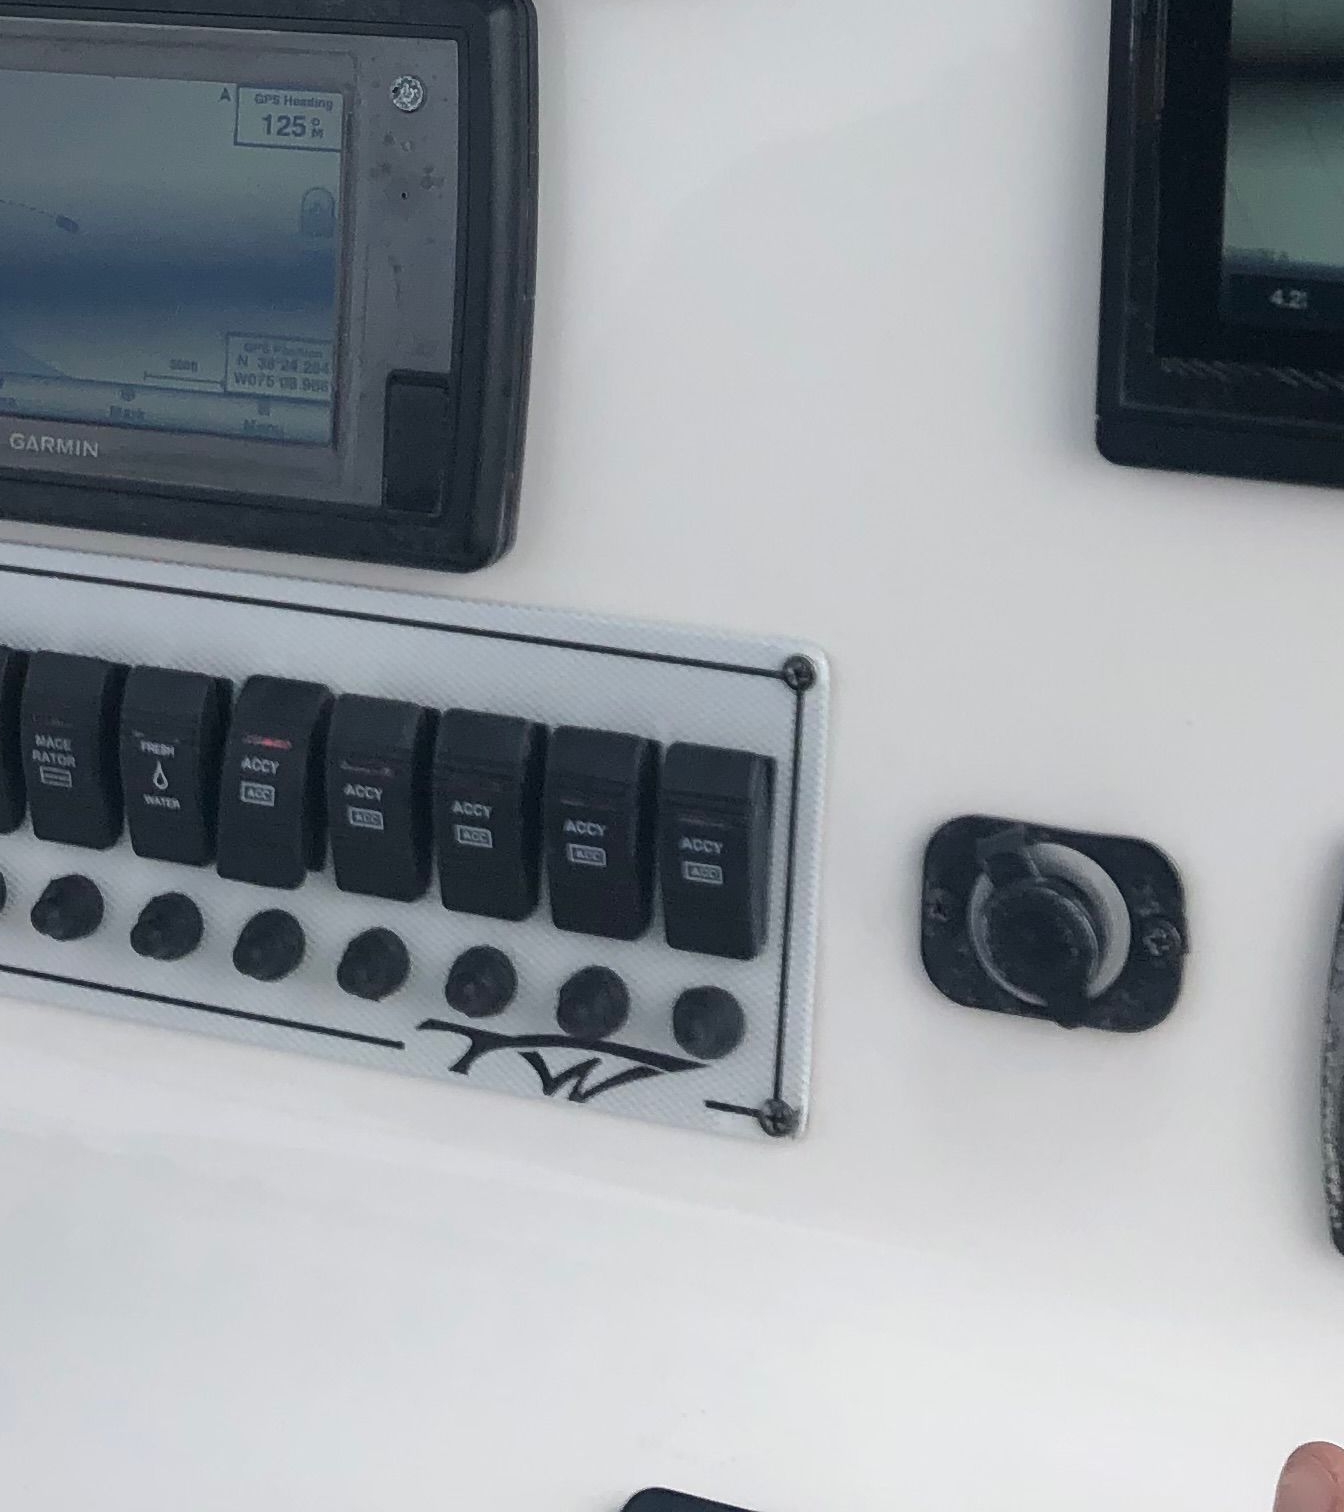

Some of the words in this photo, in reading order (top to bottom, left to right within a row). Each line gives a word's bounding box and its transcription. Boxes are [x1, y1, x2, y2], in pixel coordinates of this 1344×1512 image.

[254, 93, 281, 105] GPS
[284, 95, 333, 112] Heading
[262, 113, 306, 137] 125
[9, 433, 99, 458] GARMIN
[140, 739, 175, 758] FRESH
[32, 748, 76, 769] RATOR
[241, 755, 280, 775] ACCY
[143, 793, 181, 810] WATER
[345, 783, 384, 803] ACCY
[451, 800, 492, 819] ACCY
[563, 819, 606, 838] ACCY
[679, 836, 724, 855] ACCY
